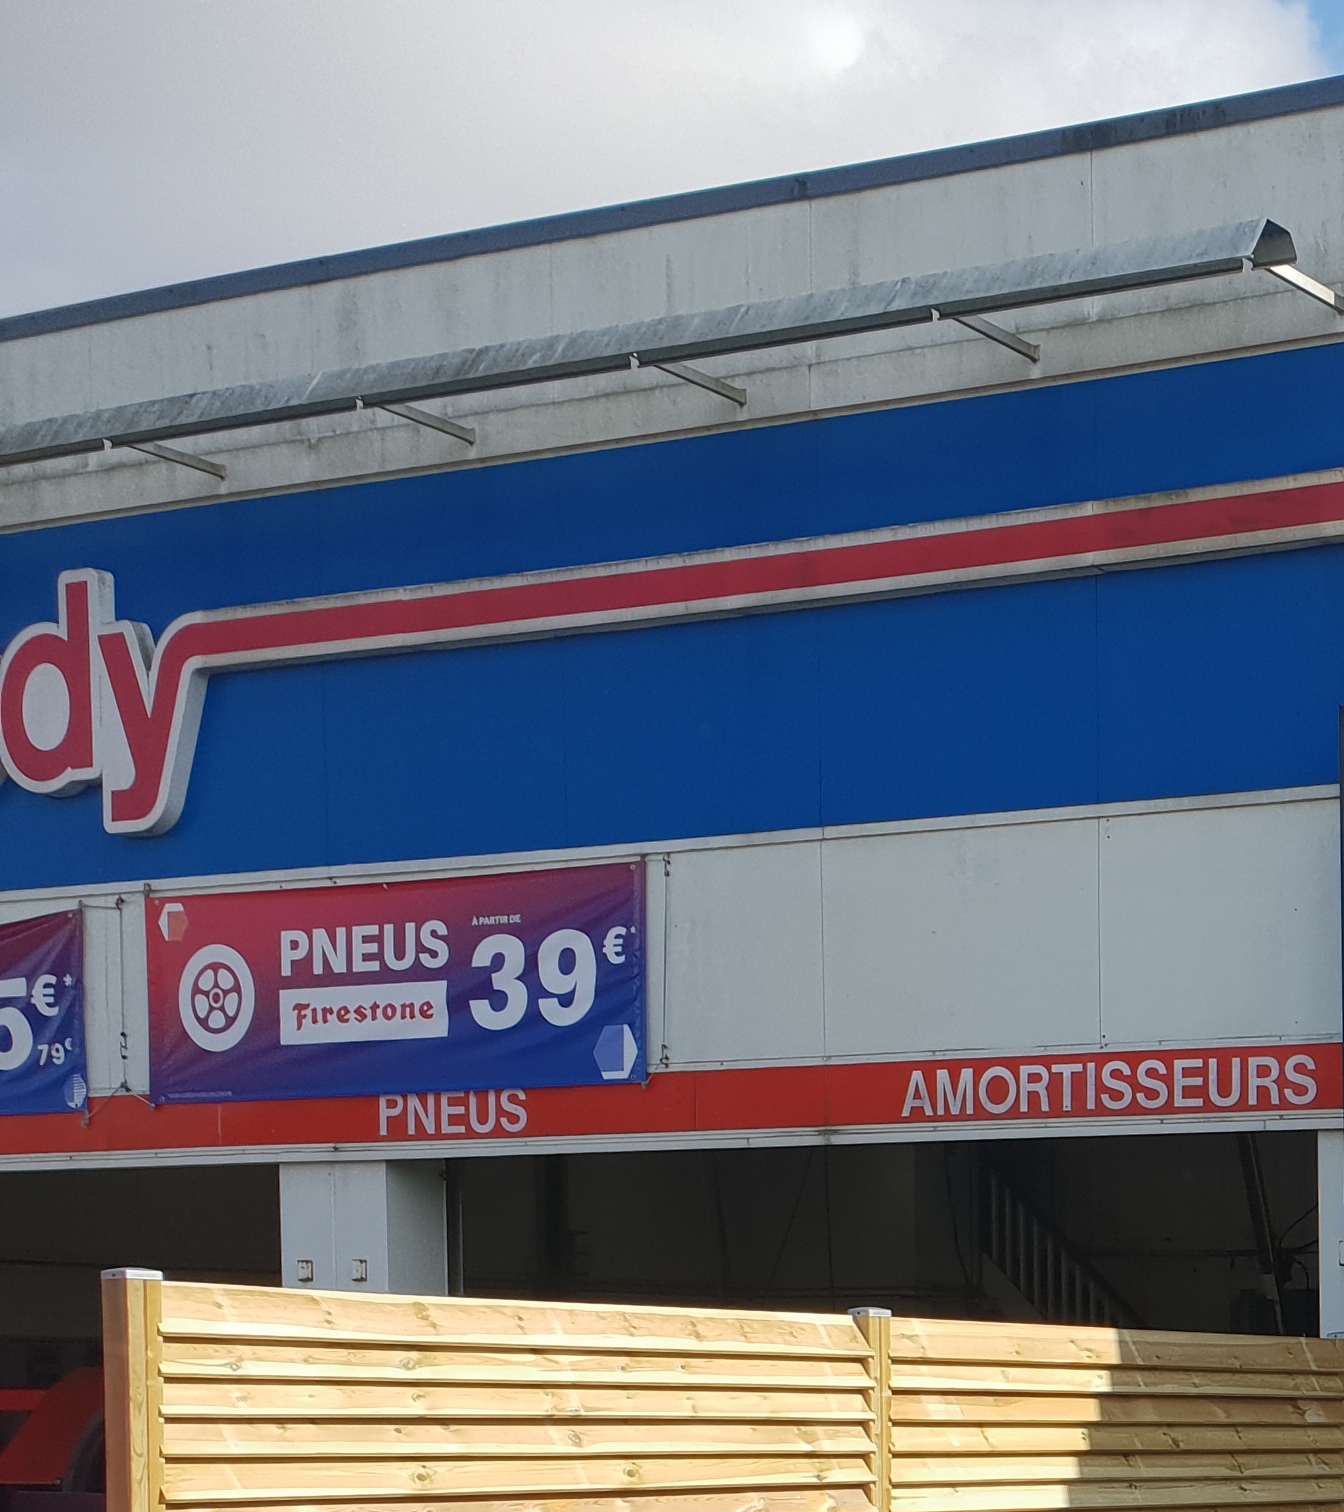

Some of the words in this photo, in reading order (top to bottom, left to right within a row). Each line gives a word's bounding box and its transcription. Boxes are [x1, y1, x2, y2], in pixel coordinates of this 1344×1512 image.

[280, 920, 450, 977] PNEUS
[292, 999, 435, 1031] Firestone
[378, 1088, 528, 1137] PNEUS
[901, 1055, 1318, 1118] AMORTISSEURS
